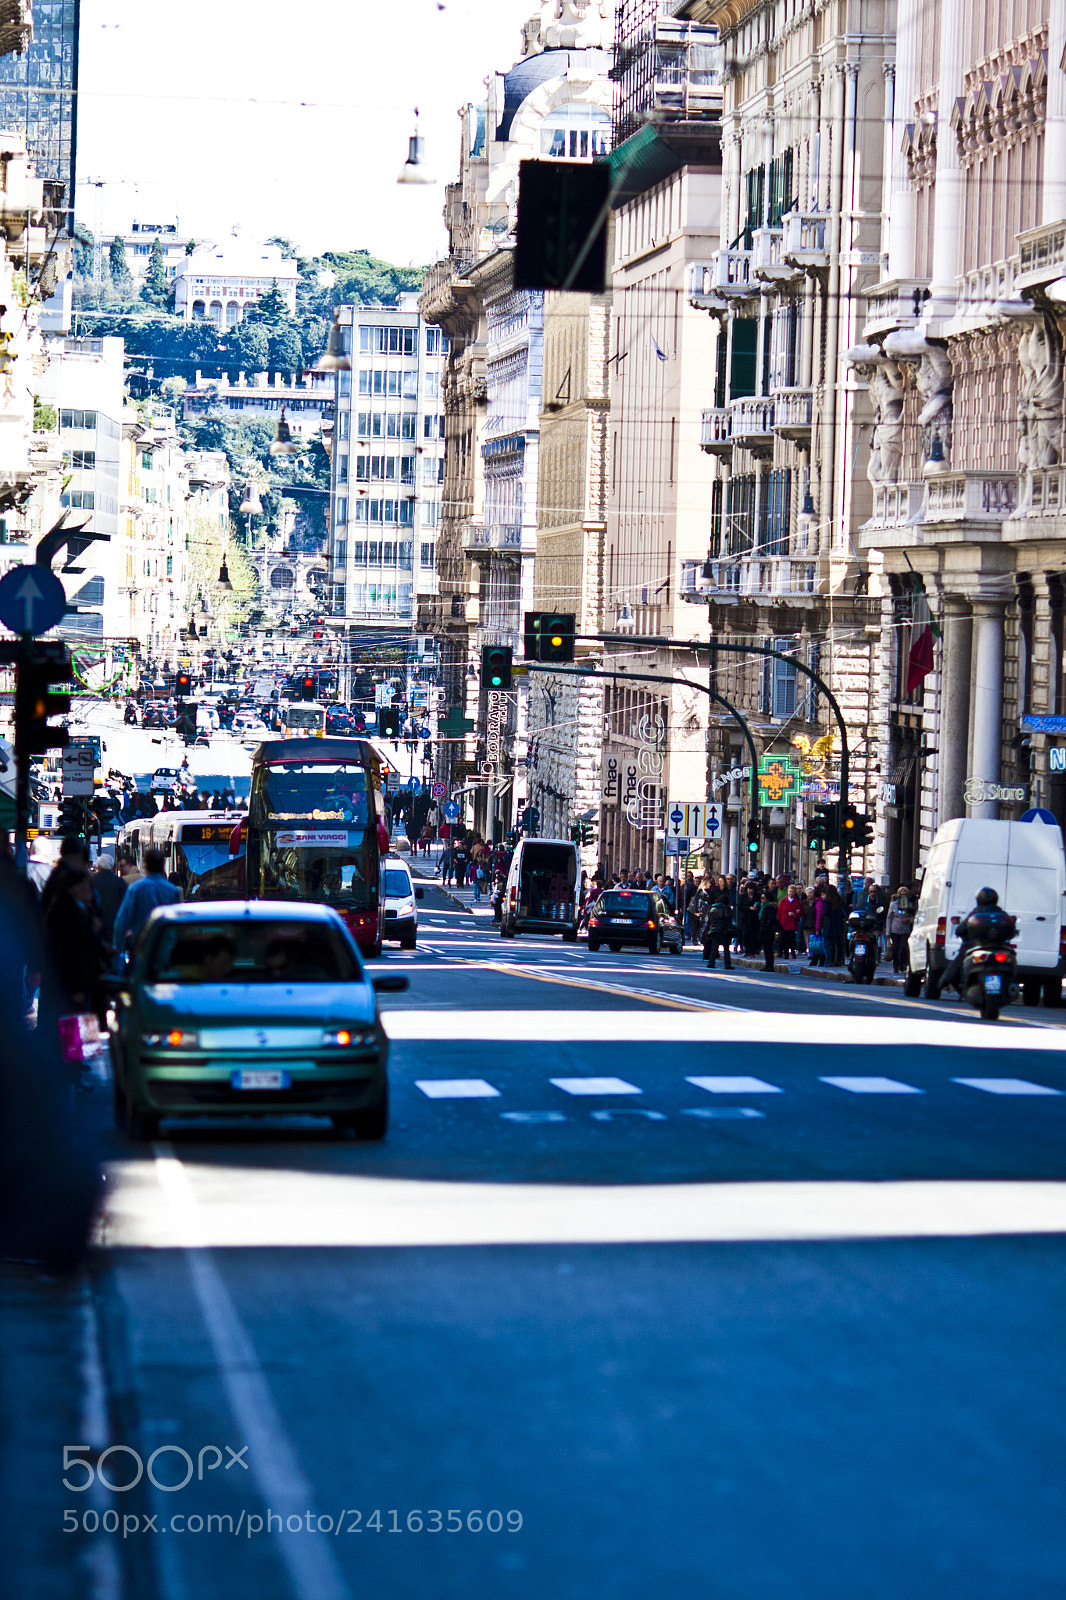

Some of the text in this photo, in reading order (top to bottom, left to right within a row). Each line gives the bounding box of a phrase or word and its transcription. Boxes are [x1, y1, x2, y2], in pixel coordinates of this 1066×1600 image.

[604, 758, 618, 798] fnac
[623, 765, 637, 806] fnac
[626, 713, 665, 829] fnac
[987, 783, 1025, 801] Store
